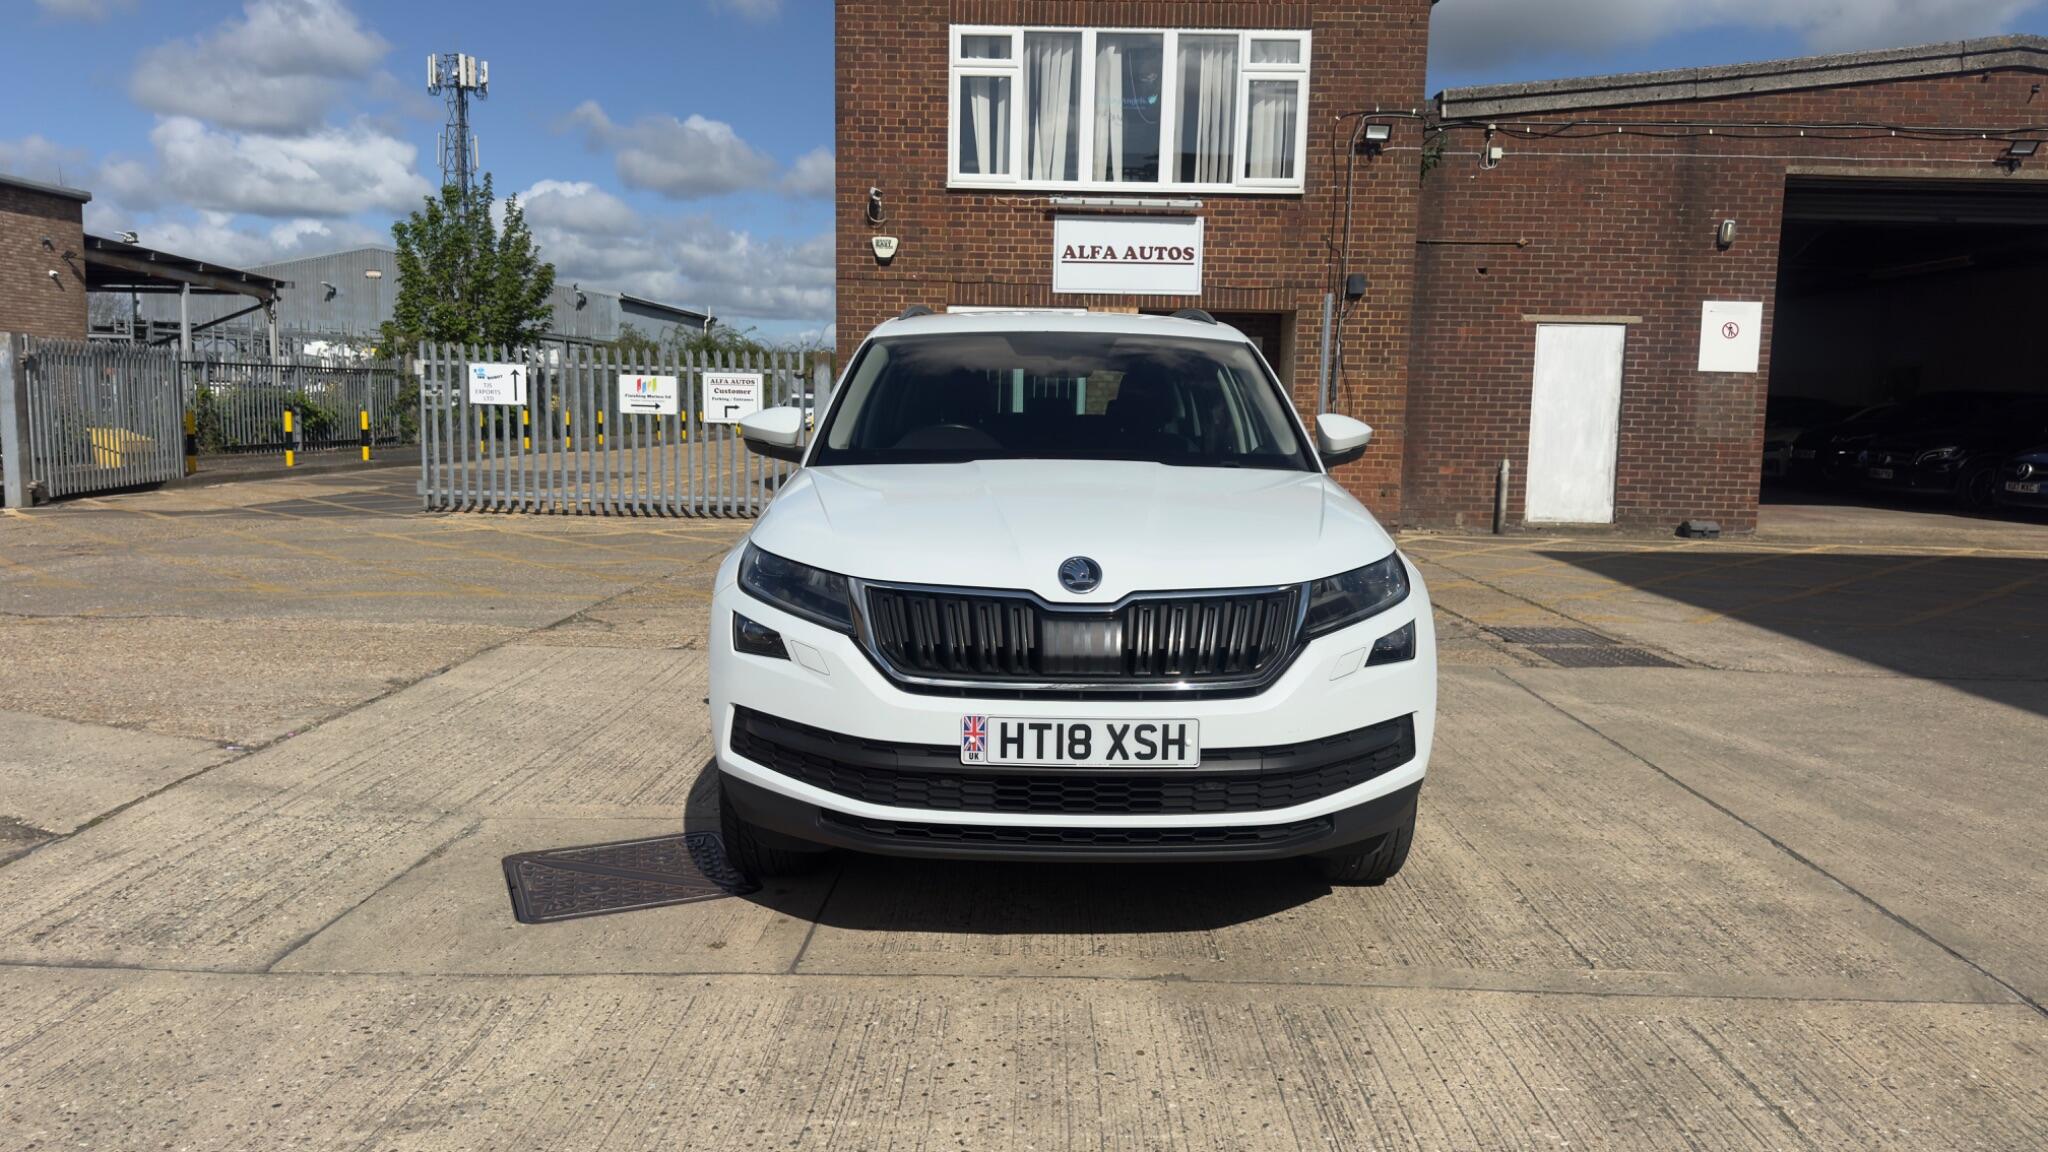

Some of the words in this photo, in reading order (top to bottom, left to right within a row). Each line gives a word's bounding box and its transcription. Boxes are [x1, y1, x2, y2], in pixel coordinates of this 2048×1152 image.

[1062, 244, 1118, 260] ALFA
[1122, 246, 1195, 261] AUTOS
[713, 387, 752, 395] Customer
[999, 721, 1092, 760] HT18
[1105, 723, 1186, 761] XSH
[968, 752, 980, 761] UK
